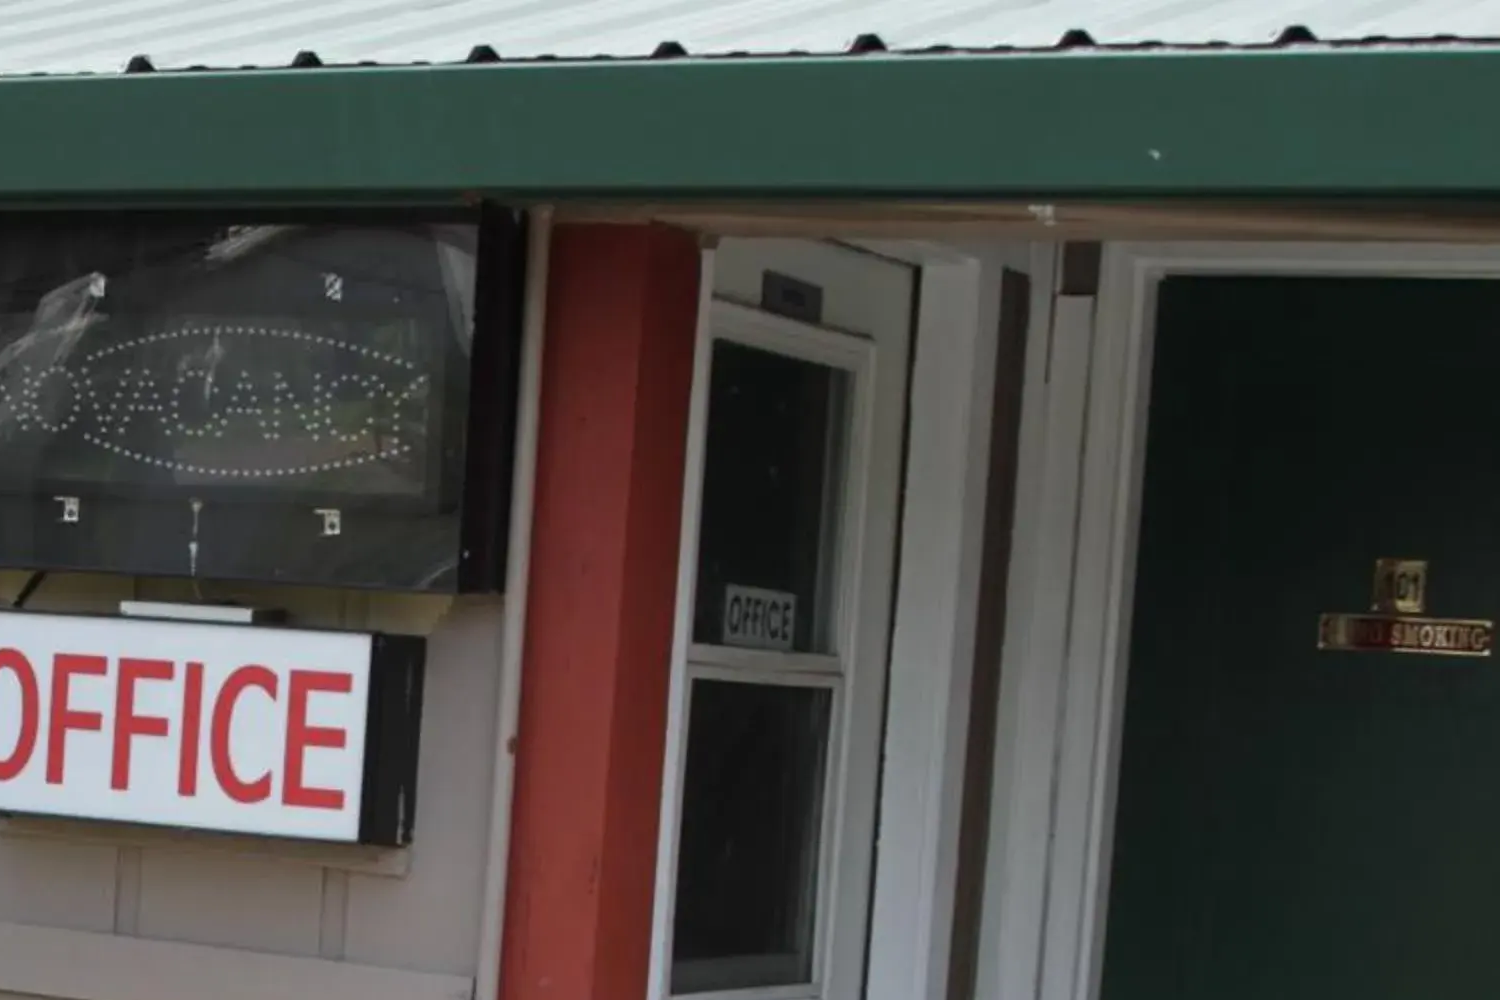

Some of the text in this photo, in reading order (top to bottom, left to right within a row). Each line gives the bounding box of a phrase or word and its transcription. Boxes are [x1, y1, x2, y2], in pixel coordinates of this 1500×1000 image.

[82, 364, 425, 443] VACANCY
[729, 595, 792, 641] OFFICE
[1390, 623, 1486, 650] SMOKING
